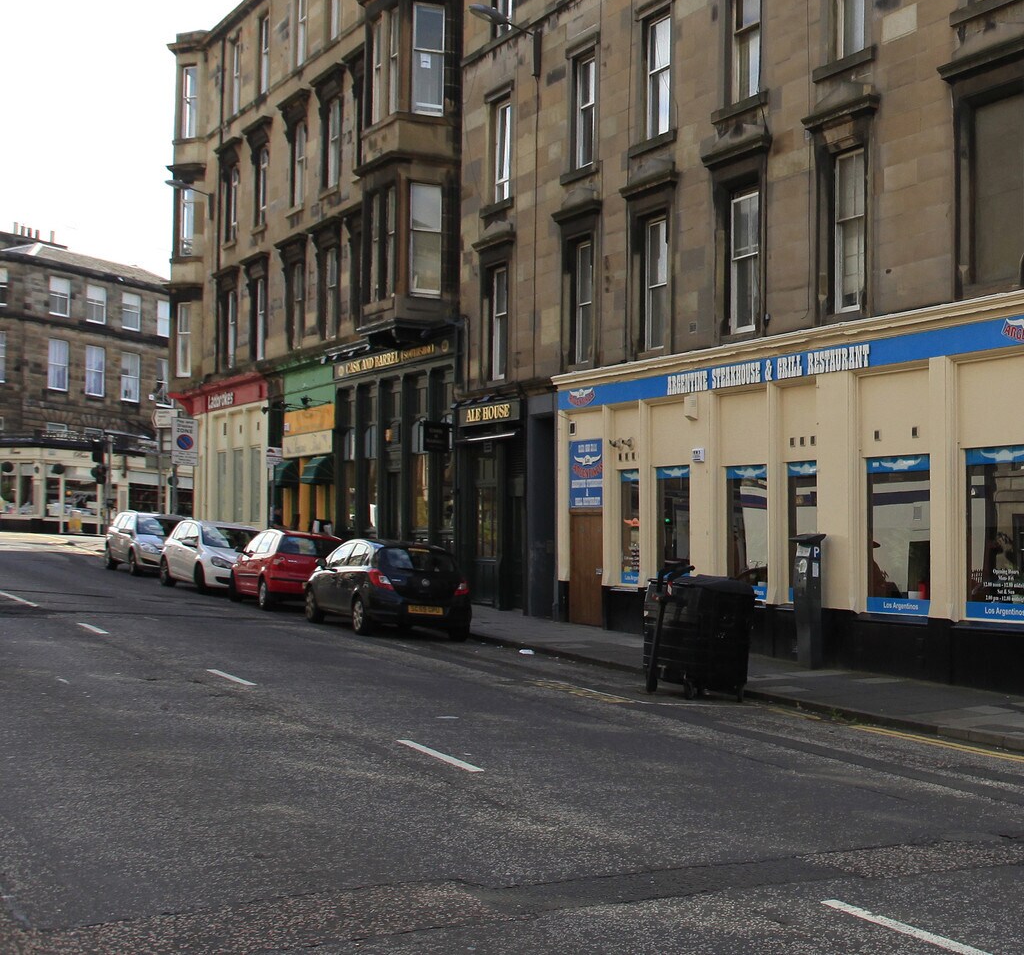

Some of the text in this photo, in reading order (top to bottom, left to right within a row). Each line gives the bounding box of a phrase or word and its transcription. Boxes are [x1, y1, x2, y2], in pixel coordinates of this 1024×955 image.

[345, 360, 361, 374] CASK
[361, 356, 375, 371] AND
[374, 350, 400, 368] BARREL
[667, 344, 870, 396] ARGENTINE STEAKHOUSE & GRILL RESTAURANT
[207, 392, 234, 410] Ladbrokes
[465, 404, 510, 423] ALE HOUSE
[813, 546, 820, 557] P
[883, 601, 919, 611] Los Argentinos
[984, 607, 995, 615] Los
